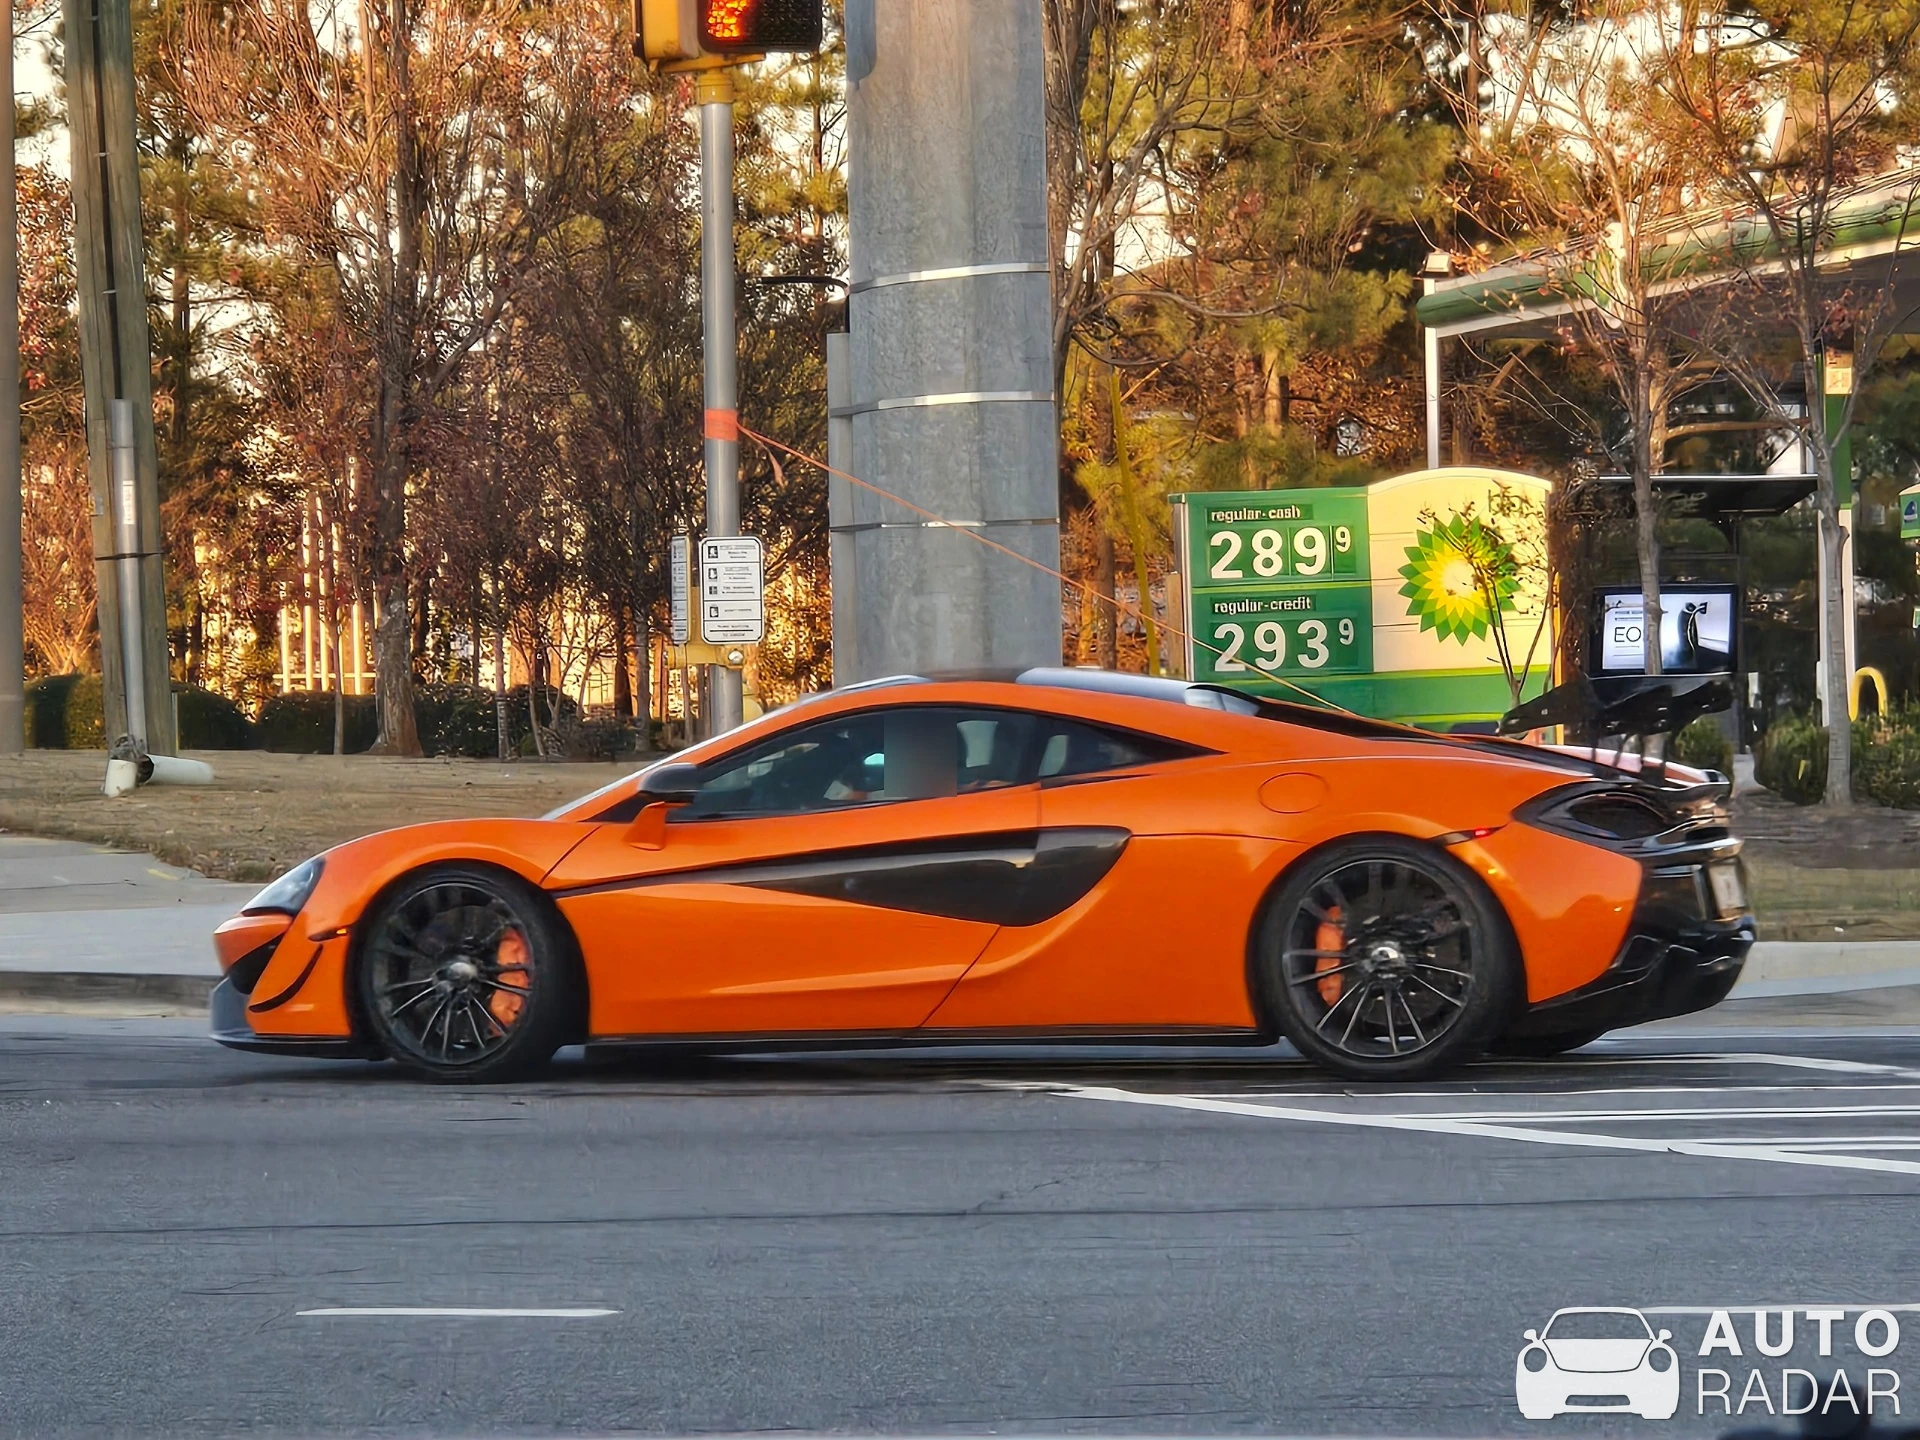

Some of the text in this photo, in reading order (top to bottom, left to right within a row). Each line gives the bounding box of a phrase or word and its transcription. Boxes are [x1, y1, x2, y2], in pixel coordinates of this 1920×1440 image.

[1210, 526, 1351, 579] 289 9
[1214, 596, 1312, 615] regular-credit
[1214, 618, 1355, 672] 293 9
